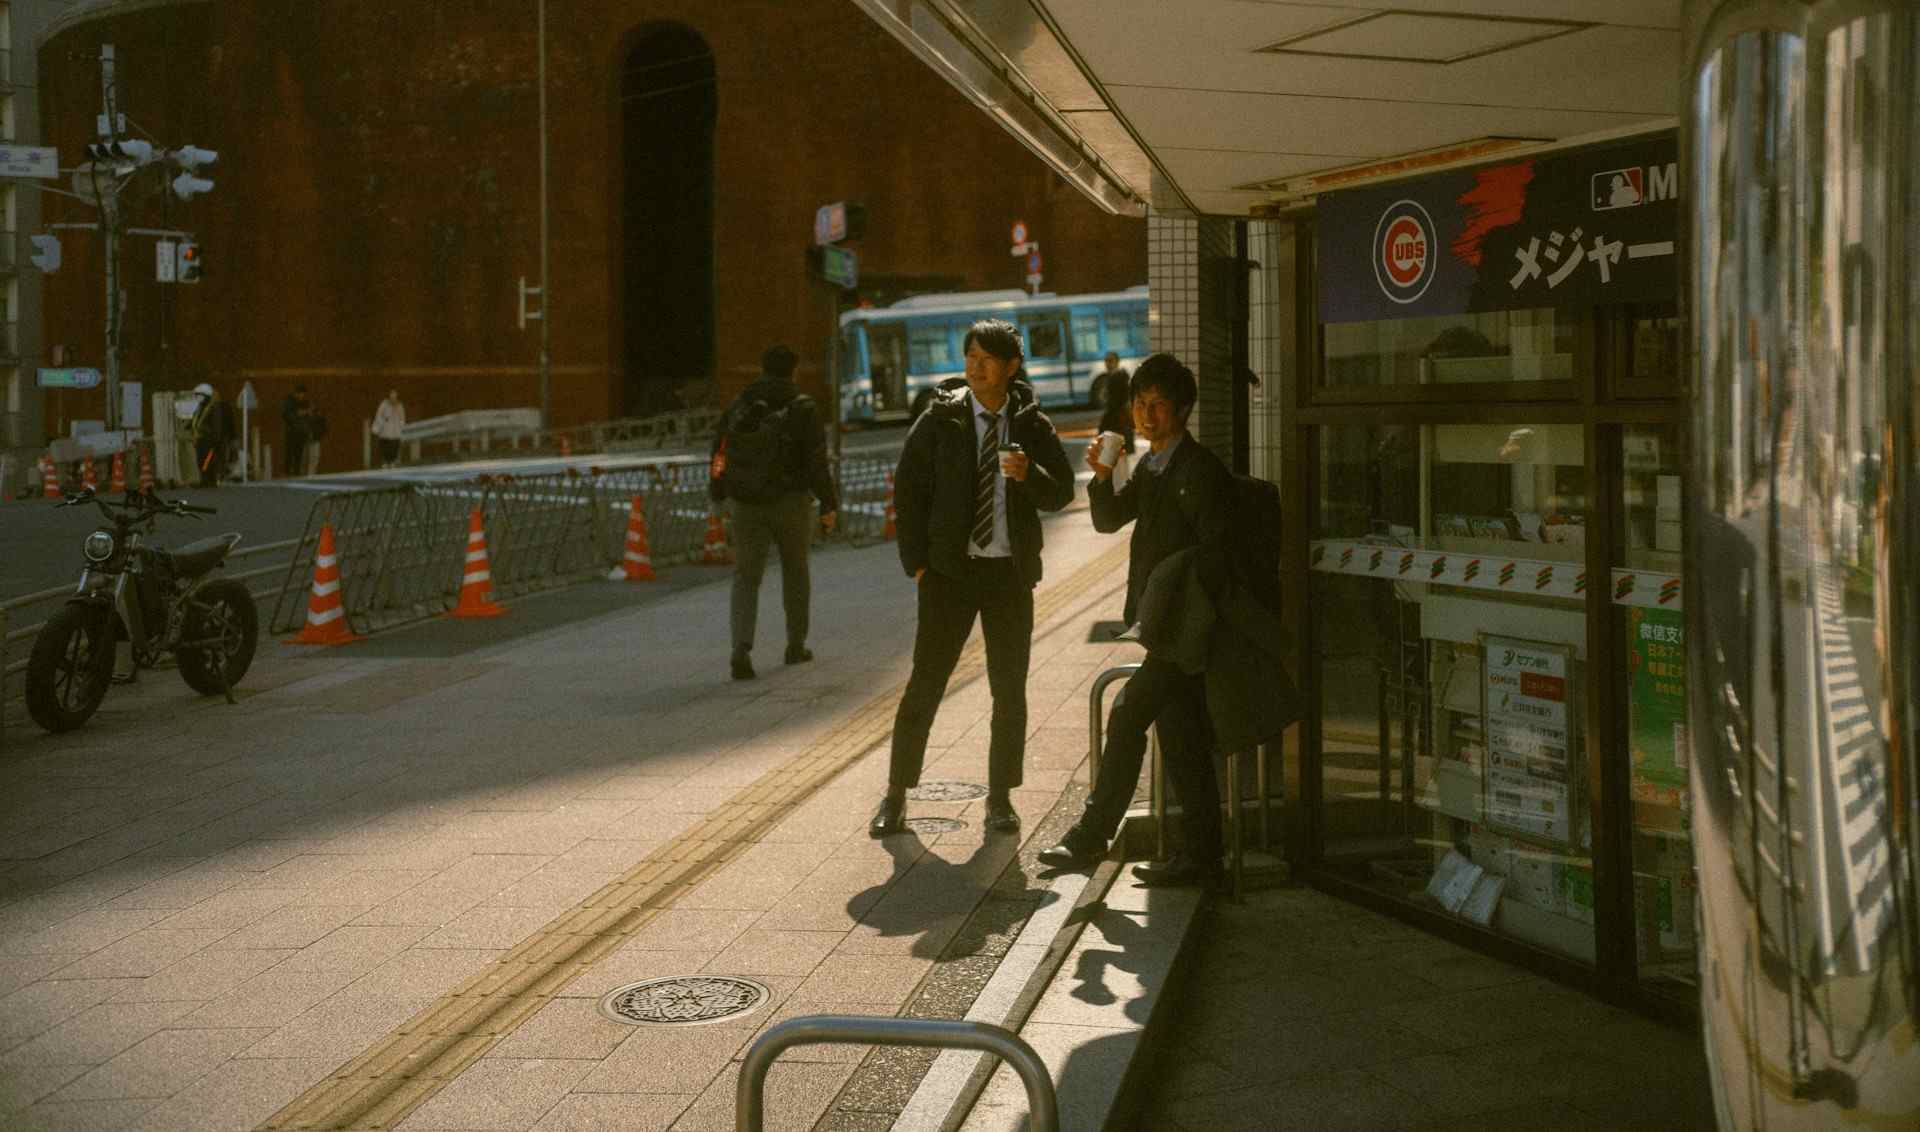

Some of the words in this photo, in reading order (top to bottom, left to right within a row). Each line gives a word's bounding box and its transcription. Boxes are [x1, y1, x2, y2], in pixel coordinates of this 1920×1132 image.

[1509, 226, 1675, 290] メジャー
[1639, 622, 1683, 644] 微信支
